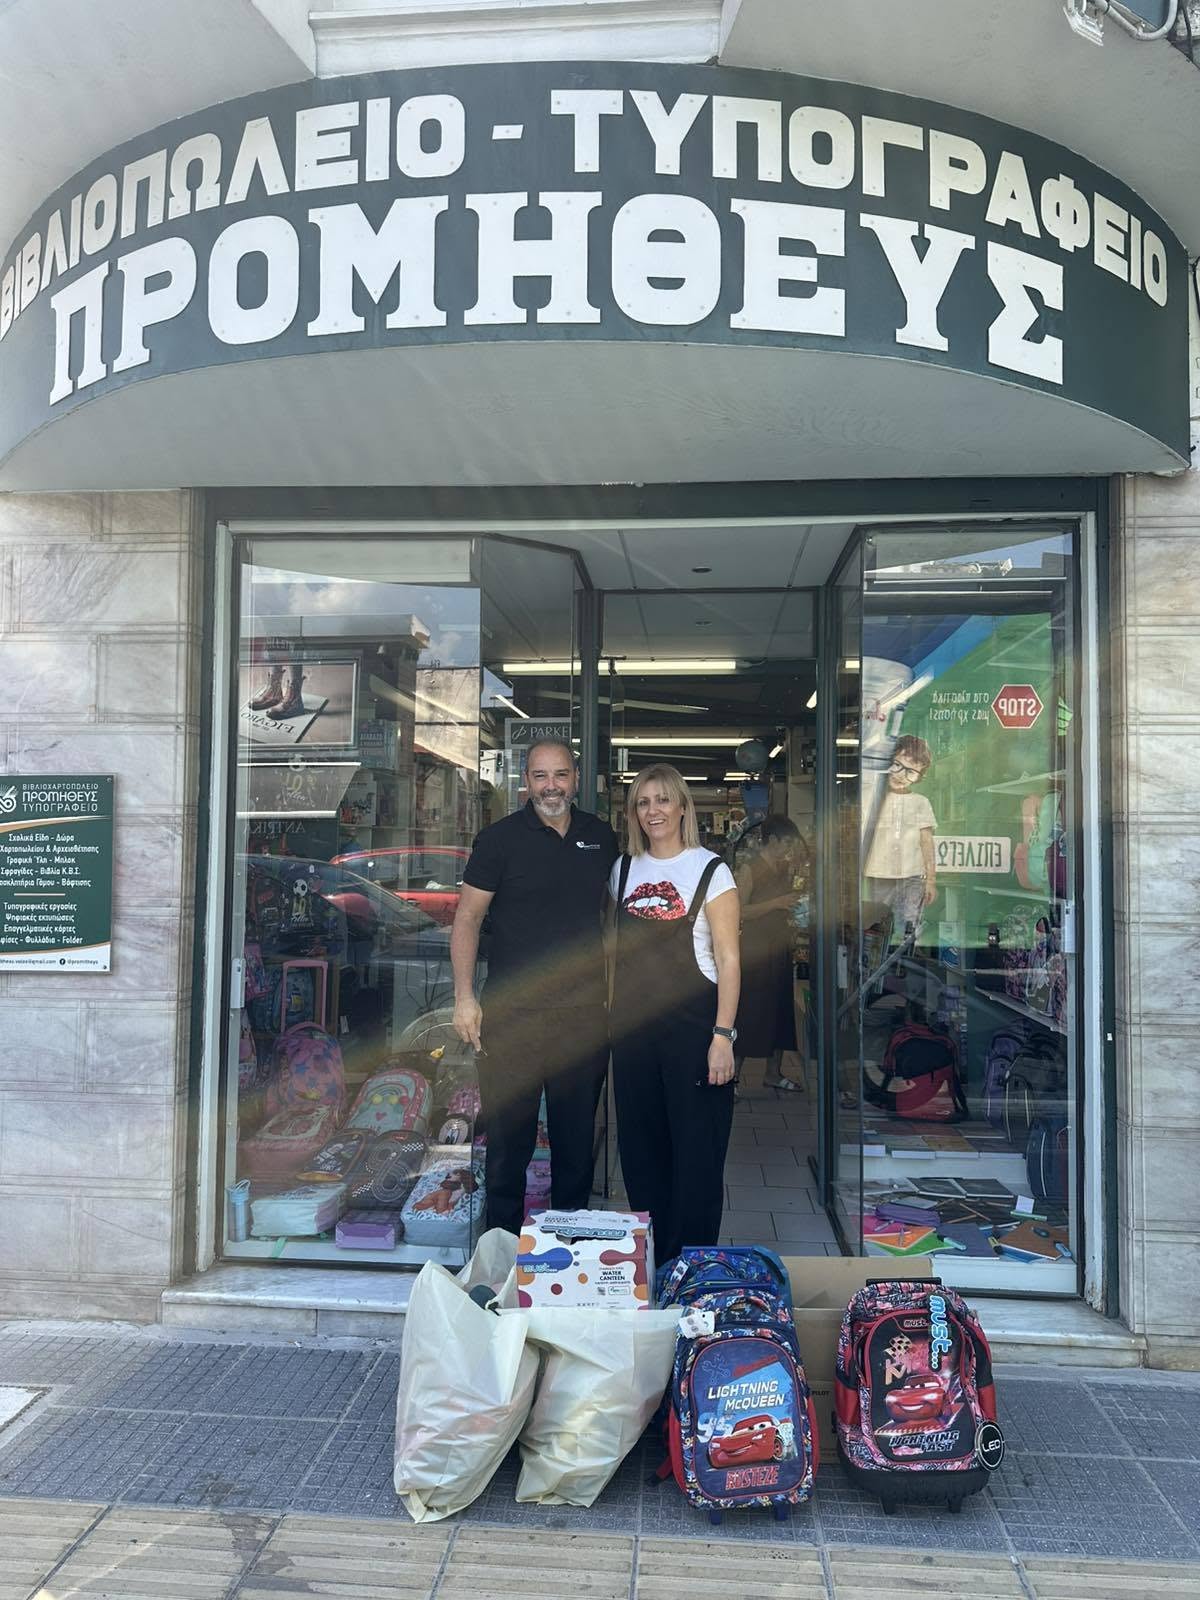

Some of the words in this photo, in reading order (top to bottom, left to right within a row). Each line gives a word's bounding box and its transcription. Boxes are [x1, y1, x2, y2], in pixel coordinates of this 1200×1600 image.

[0, 94, 466, 342] ΒΙΒΛΙΟΠΩΛΕΙΟ
[551, 89, 1168, 308] ΤΥΠΟΓΡΑΦΕΙΟ
[49, 191, 1064, 407] ΠΡΟΜΗΘΕΥΣ
[22, 791, 98, 802] ΠΡΟΜΗΘΕΥΣ
[22, 803, 98, 812] ΤΥΠΟΓΡΑΦΕΙΟ
[0, 935, 19, 945] φίσες
[708, 1380, 779, 1400] LIGHTNING
[889, 1430, 960, 1447] LIGHTNING
[982, 1439, 1001, 1453] LED
